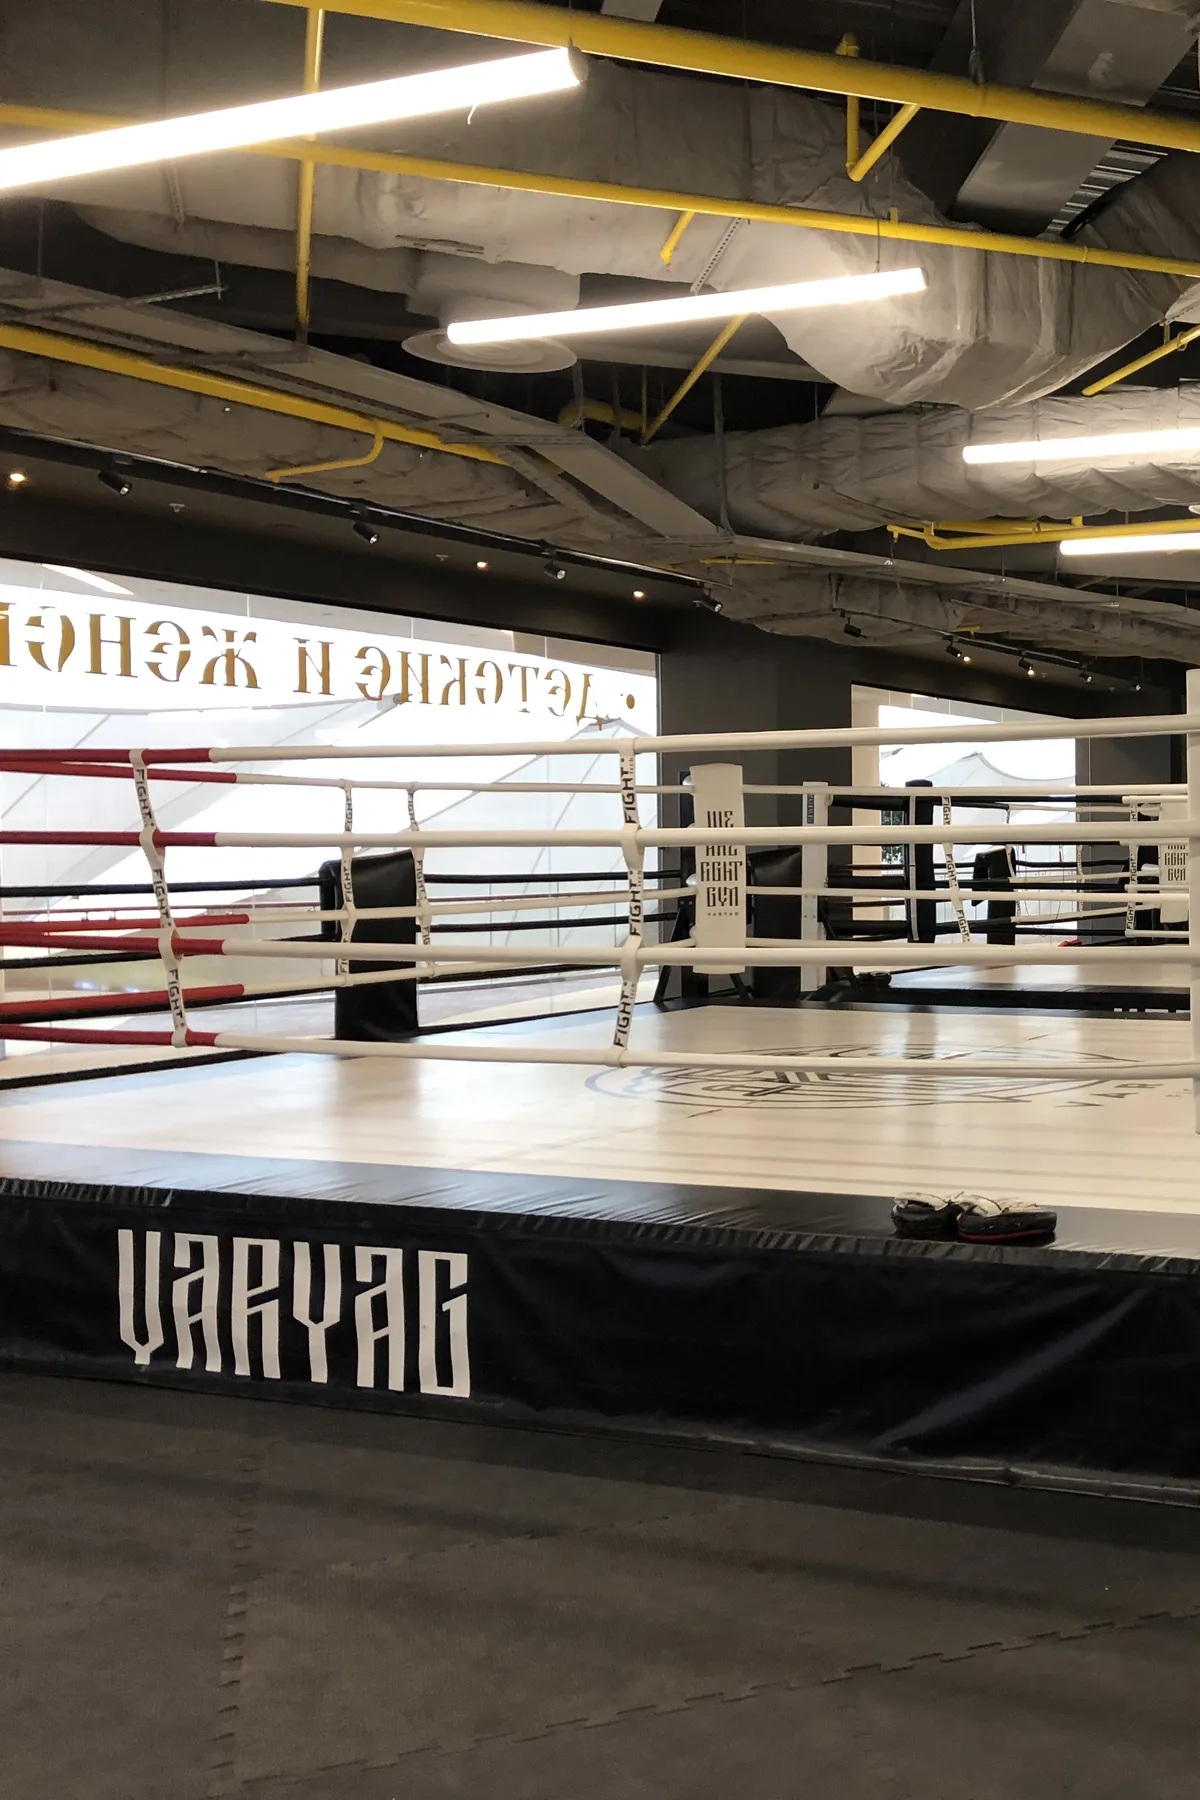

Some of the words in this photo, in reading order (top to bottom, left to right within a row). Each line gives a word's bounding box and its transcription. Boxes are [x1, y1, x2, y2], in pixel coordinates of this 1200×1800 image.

[135, 769, 152, 821] FIGHT
[621, 767, 637, 824] FIGHT
[343, 867, 353, 902] FIGHT
[946, 853, 957, 882] FIGHT
[152, 869, 170, 922] FIGHT
[629, 880, 642, 936] FIGHT
[707, 887, 738, 907] GYM
[957, 910, 969, 937] FIGHT
[168, 968, 183, 1019] FIGHT
[613, 993, 632, 1047] FIGHT
[117, 1229, 471, 1398] VARYAG
